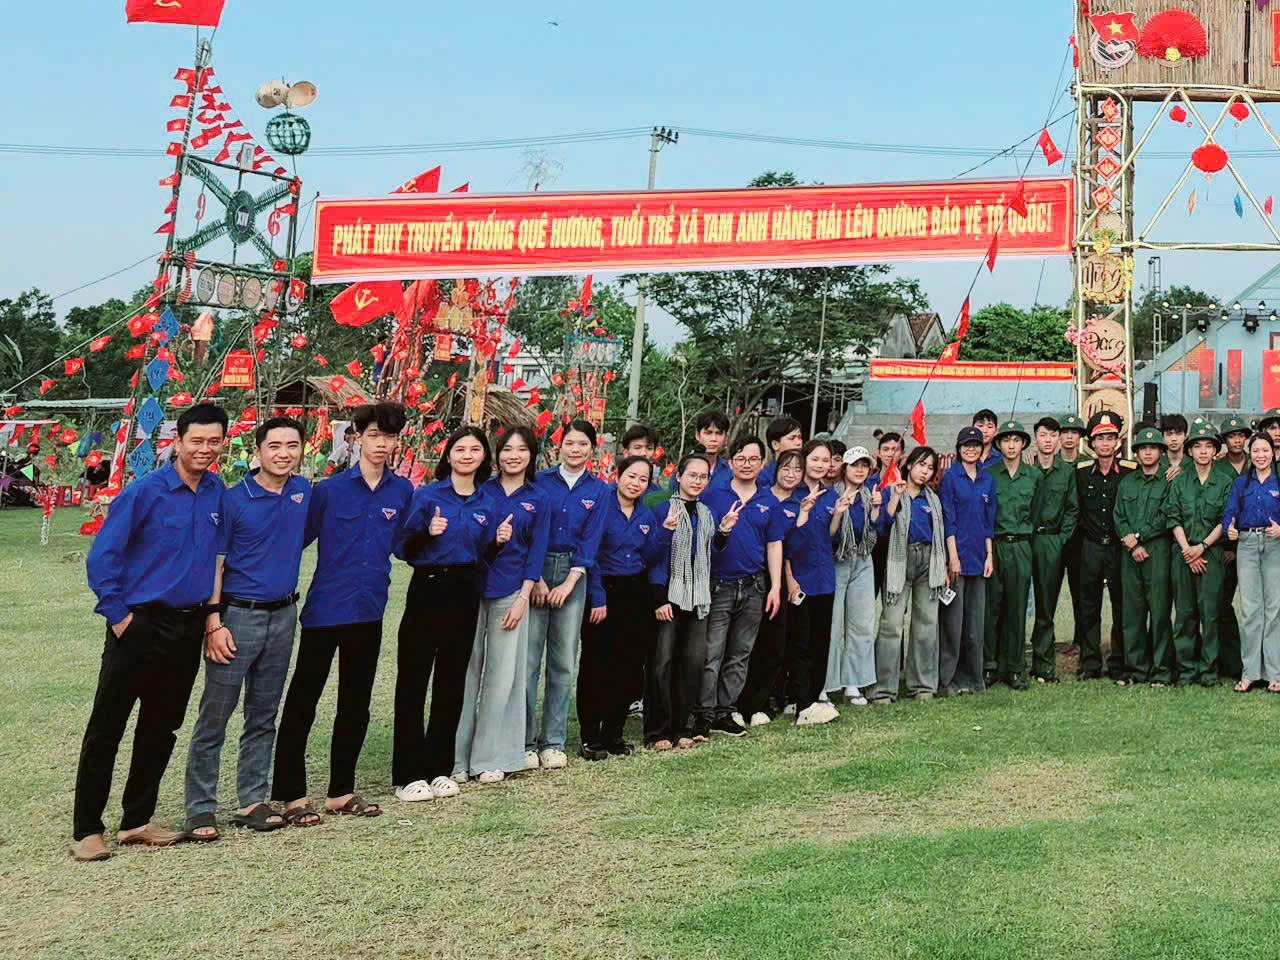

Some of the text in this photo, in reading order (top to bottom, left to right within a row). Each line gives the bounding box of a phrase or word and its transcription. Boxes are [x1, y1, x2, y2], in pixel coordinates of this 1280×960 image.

[333, 217, 371, 256] PHÁT
[375, 223, 402, 254] HUY
[406, 211, 462, 253] TRUYỀN
[466, 209, 514, 251] THỐNG
[518, 212, 547, 253] QUÊ
[550, 214, 604, 250] HƯƠNG,
[611, 203, 642, 247] TUỔI
[648, 204, 674, 245] TRẺ
[679, 208, 698, 244] XÃ
[703, 213, 733, 243] TAM
[736, 211, 768, 242] ANH
[772, 203, 814, 241] HĂNG
[816, 203, 842, 239] HÁI
[846, 202, 873, 238] LÊN
[877, 201, 927, 237] ĐƯỜNG
[932, 195, 961, 237] BẢO
[965, 199, 983, 241] VỆ
[987, 193, 1004, 235] TỔ
